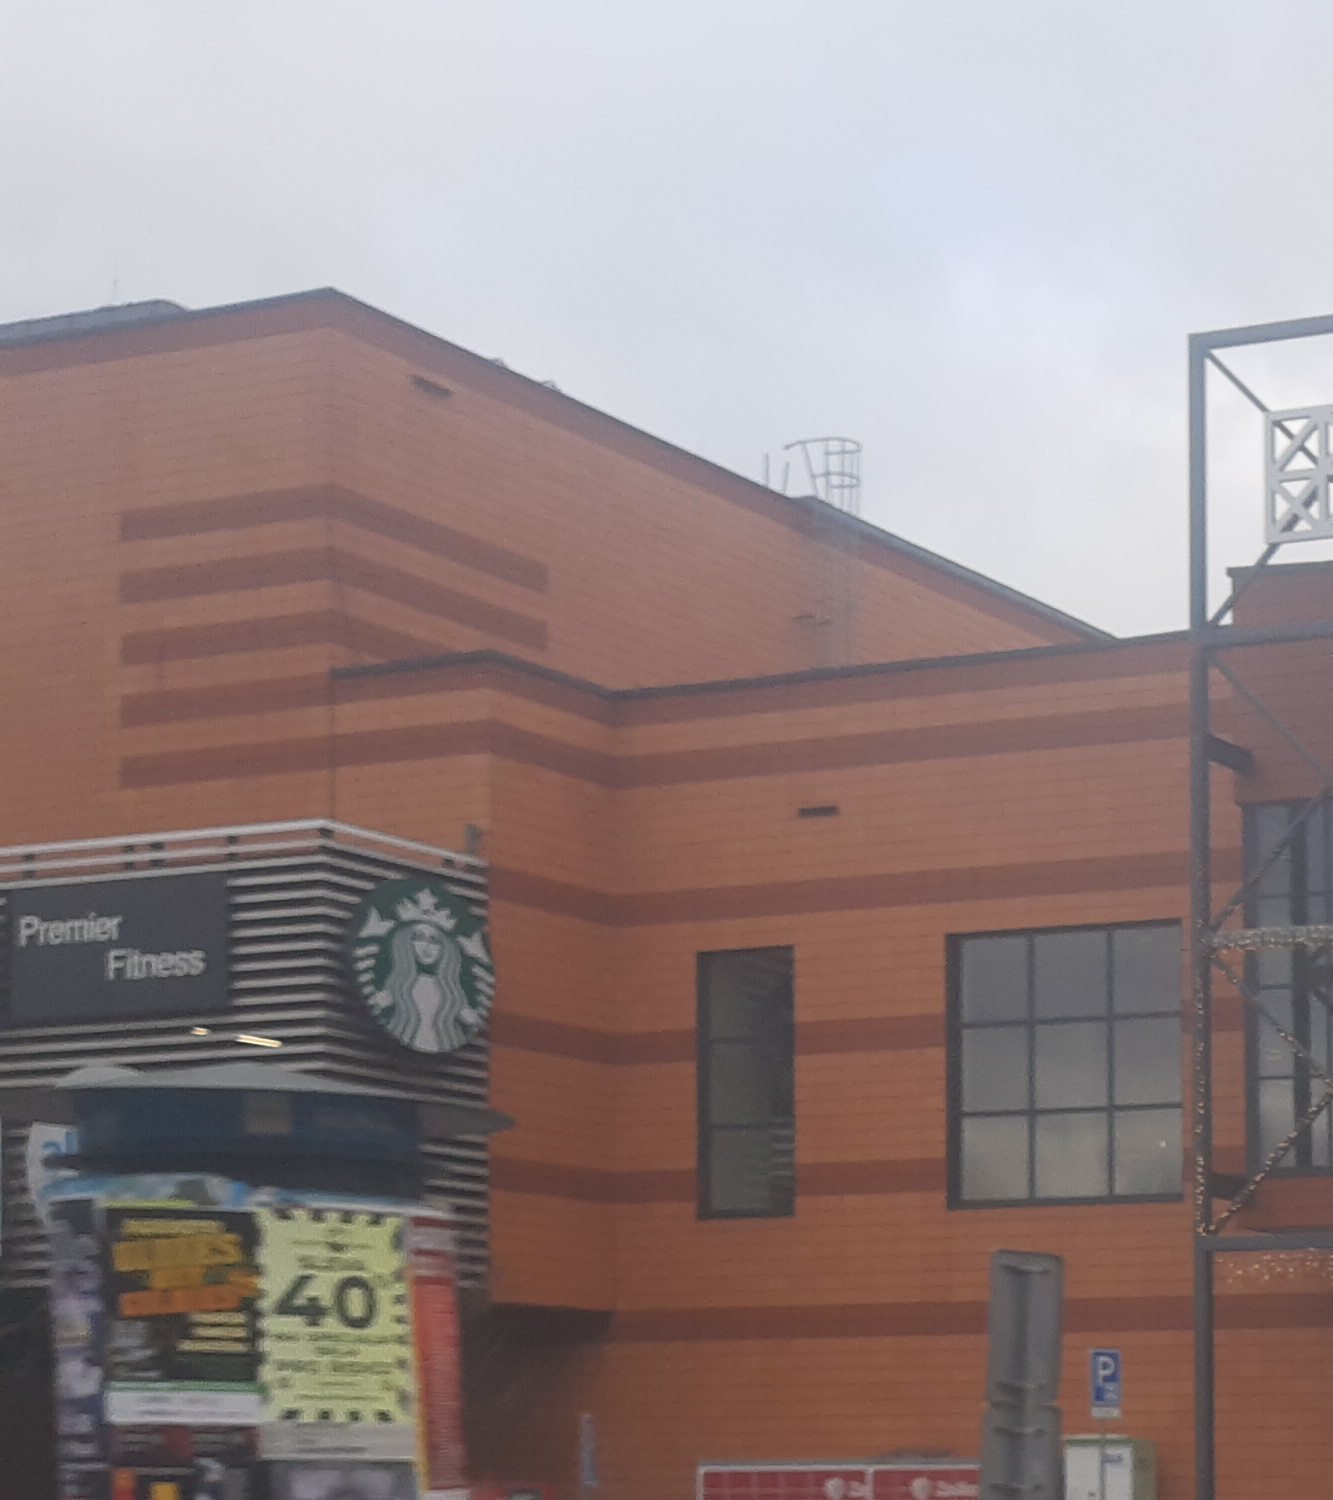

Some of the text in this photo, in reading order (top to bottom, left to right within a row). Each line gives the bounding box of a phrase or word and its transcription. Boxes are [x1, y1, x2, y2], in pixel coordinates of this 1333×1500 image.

[18, 911, 123, 948] Premier
[104, 948, 207, 981] Fitness
[273, 1273, 378, 1330] 40
